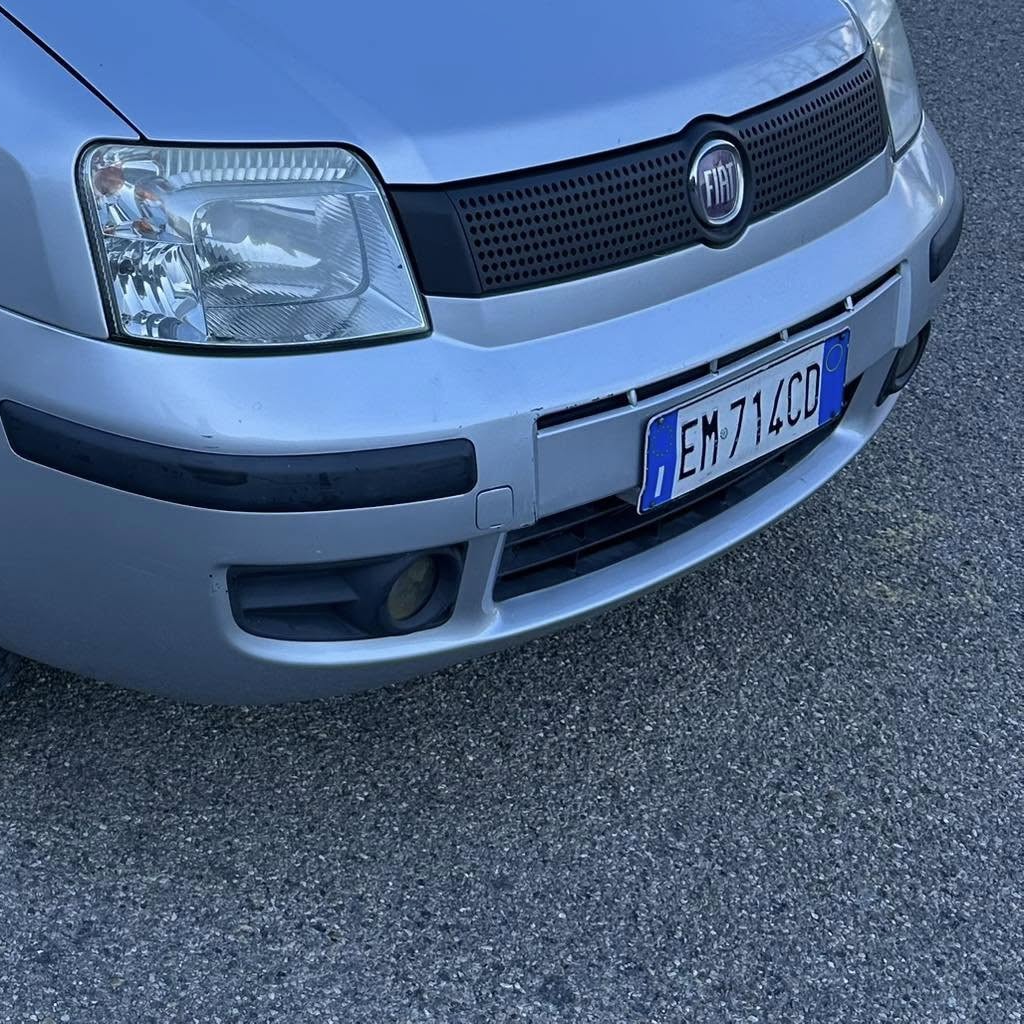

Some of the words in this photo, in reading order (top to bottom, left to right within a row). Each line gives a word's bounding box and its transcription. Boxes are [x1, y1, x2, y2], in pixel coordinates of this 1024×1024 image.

[703, 160, 734, 209] FIAT
[679, 408, 719, 481] EM
[728, 362, 821, 459] 714CD
